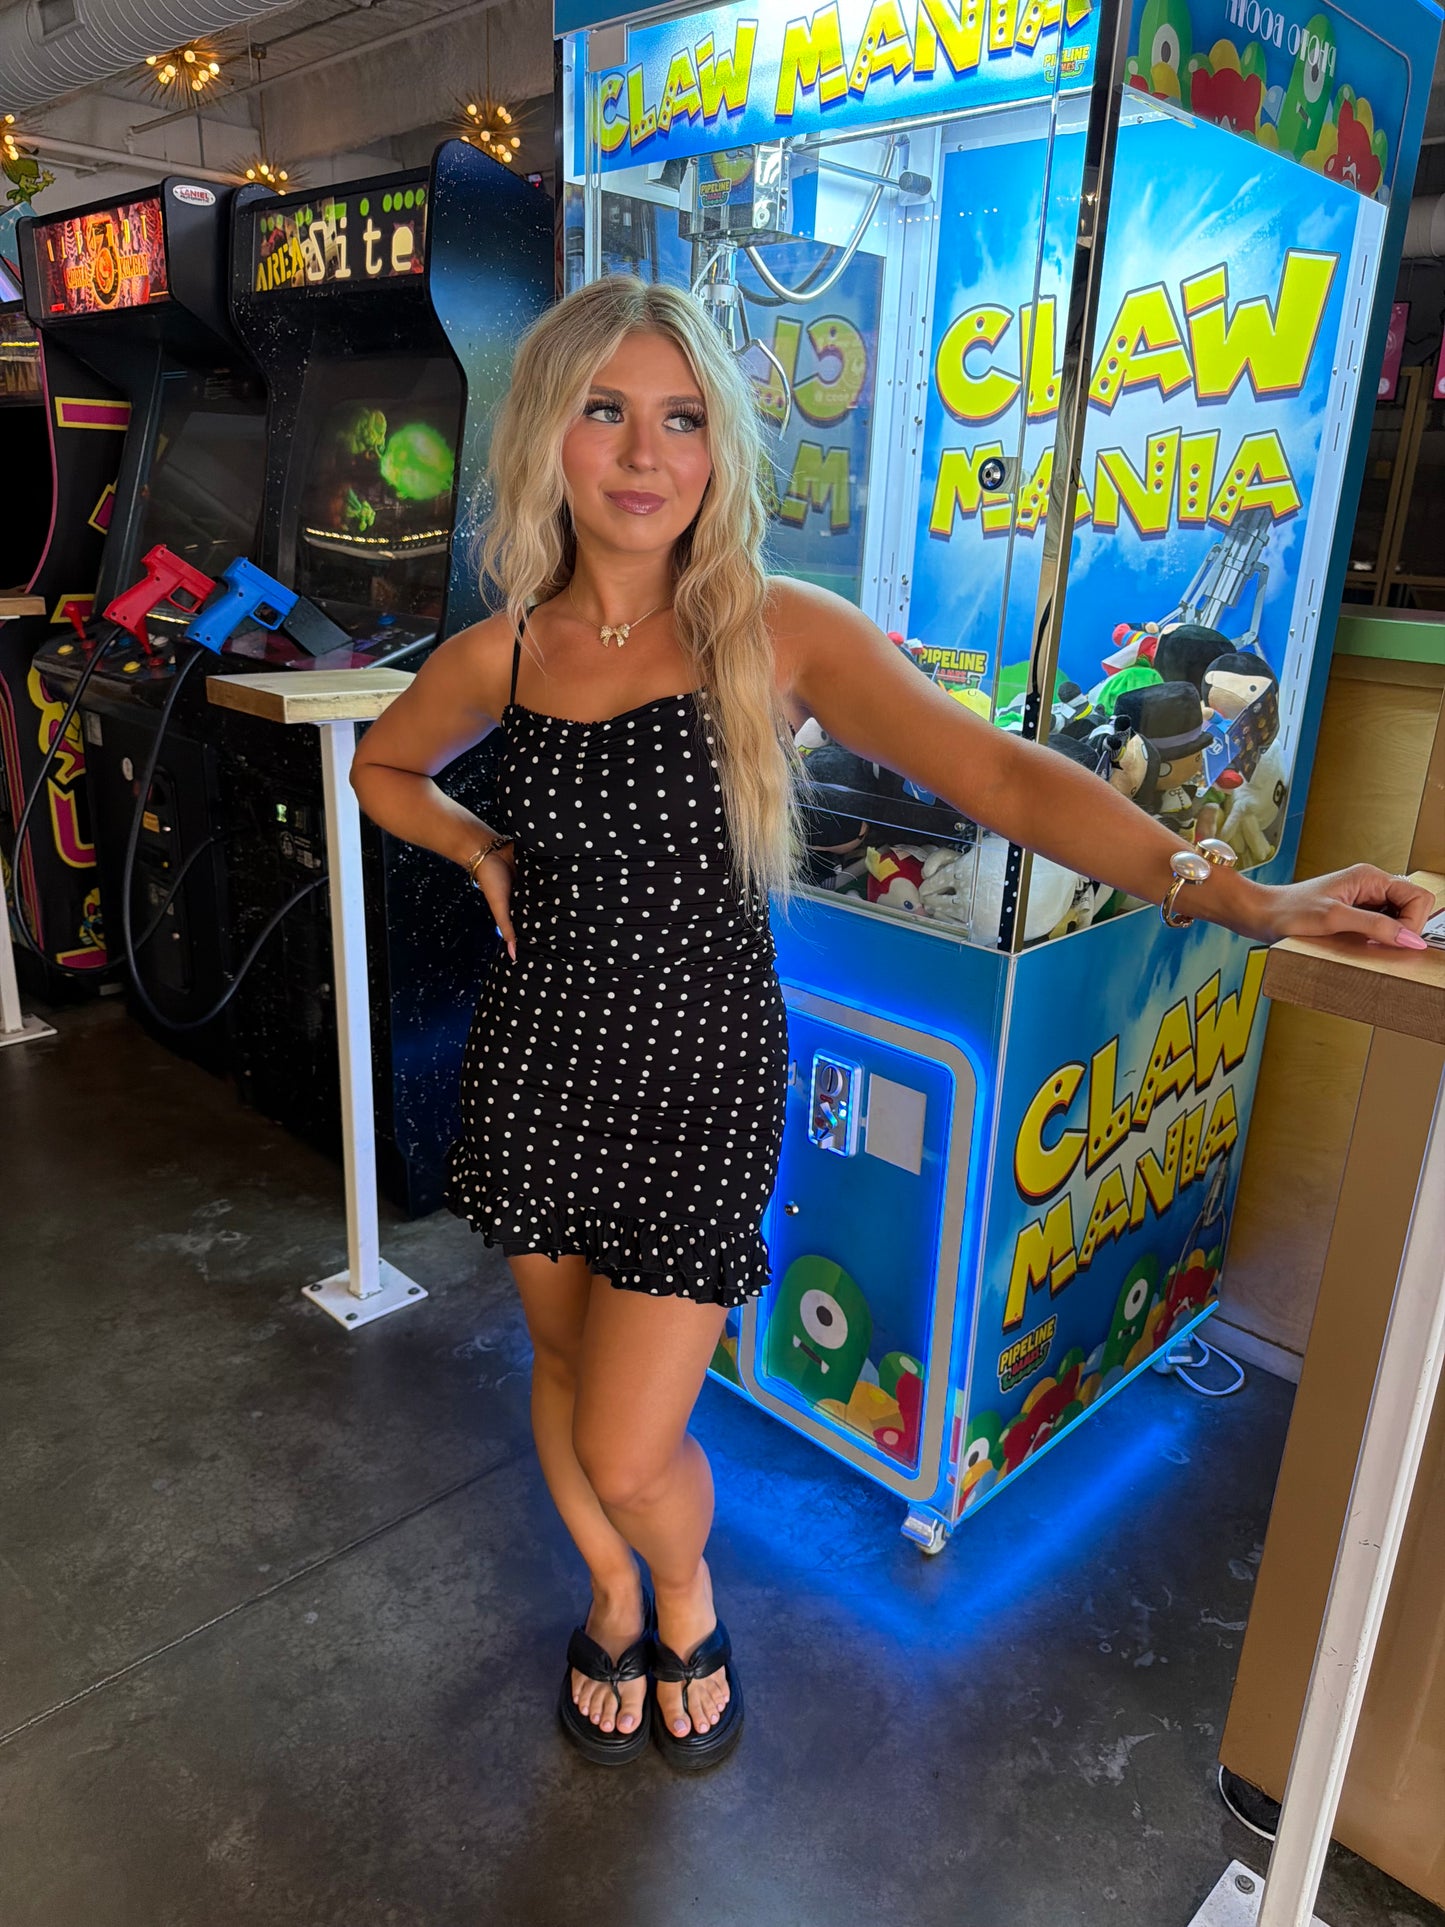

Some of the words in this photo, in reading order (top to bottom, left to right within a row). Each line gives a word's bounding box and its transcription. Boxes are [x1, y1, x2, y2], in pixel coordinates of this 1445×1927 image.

[593, 18, 759, 156] CLAW
[256, 236, 305, 292] AREA
[936, 248, 1341, 423] CLAW
[929, 426, 1303, 541] MANIA
[918, 648, 987, 673] PIPELINE
[1014, 945, 1269, 1206] CLAW
[1002, 1084, 1238, 1334] MANIA
[999, 1317, 1056, 1374] PIPELINE
